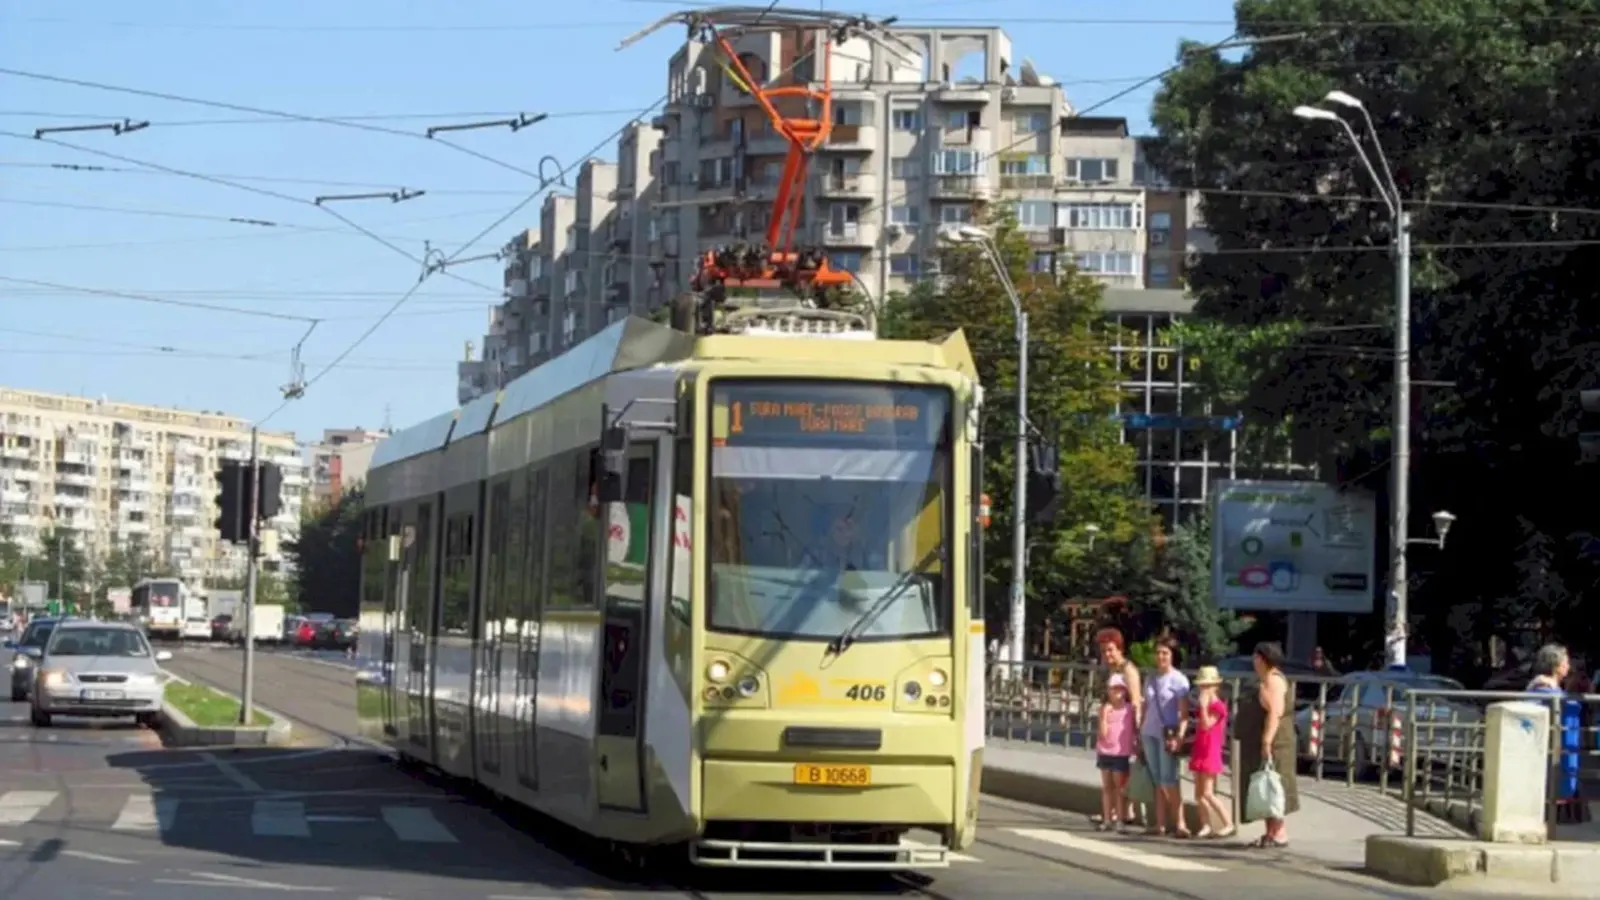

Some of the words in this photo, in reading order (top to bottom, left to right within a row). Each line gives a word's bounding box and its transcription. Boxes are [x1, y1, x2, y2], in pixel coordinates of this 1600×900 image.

[731, 401, 743, 432] 1
[845, 683, 886, 701] 406
[808, 766, 821, 782] B
[825, 767, 867, 784] 10668
